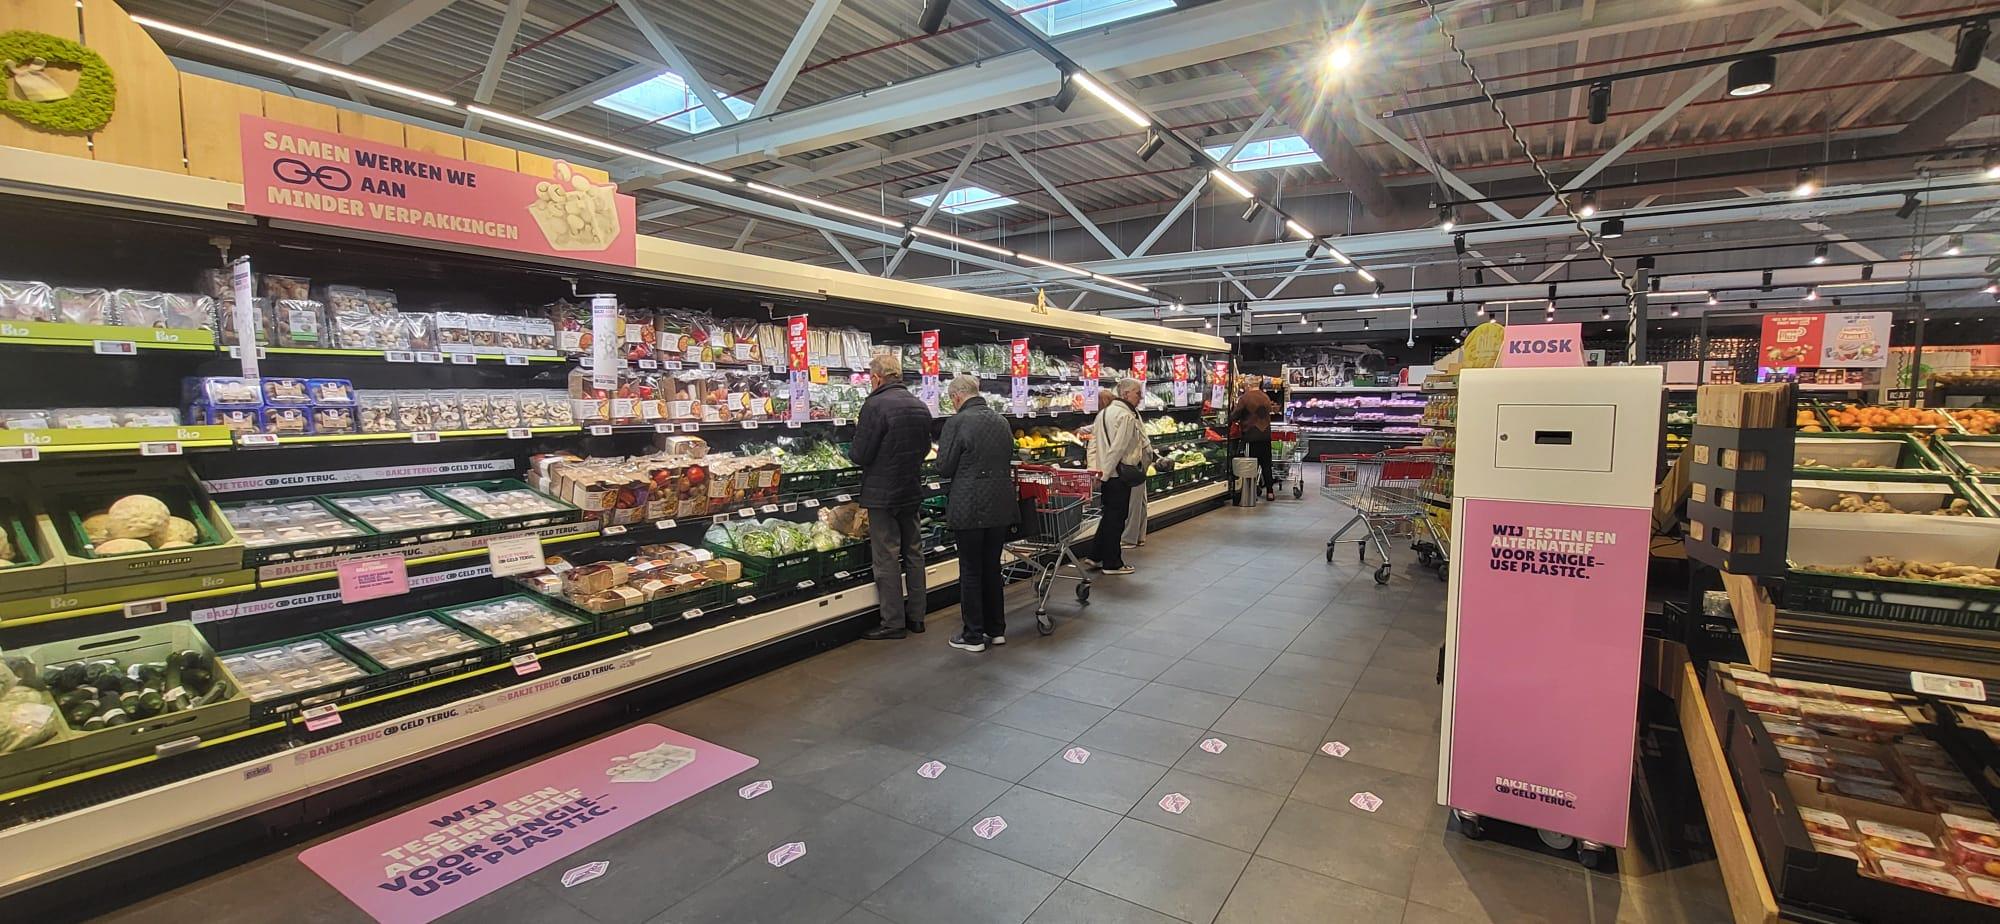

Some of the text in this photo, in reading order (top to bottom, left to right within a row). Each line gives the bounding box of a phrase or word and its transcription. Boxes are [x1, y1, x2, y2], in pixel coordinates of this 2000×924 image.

[264, 131, 477, 187] SAMEN WERKEN WE
[361, 177, 406, 198] AAN
[268, 186, 519, 240] MINDER VERPAKKINGEN
[1508, 338, 1573, 354] KIOSK
[385, 469, 411, 477] BAKJE
[470, 462, 495, 470] TERUG.
[231, 479, 264, 489] TERUG
[281, 477, 304, 486] GELD
[306, 473, 337, 482] TERUG.
[555, 526, 579, 534] TERUG.
[1492, 524, 1616, 544] WIJ TESTEN EEN
[1491, 535, 1593, 555] ALTERNATIEF
[1491, 547, 1536, 561] VOOR
[276, 563, 311, 575] BAKJE
[421, 574, 446, 584] TERUG
[457, 569, 476, 577] GELD
[1490, 559, 1590, 579] USE PLASTIC.
[207, 591, 341, 619] BAKJE TERUG GELD TERU
[507, 663, 616, 700] BAKJE TERUG GELD TERUG.
[308, 708, 459, 758] BAKJE TERUG GELD TERUG.
[1495, 776, 1565, 799] BAKJE TERUG
[1511, 788, 1577, 809] GELD TERUG.
[381, 786, 561, 860] TESTEN EEN
[429, 799, 498, 828] WIJ
[383, 788, 584, 879] ALTERNATIEF
[407, 804, 619, 897] USE PLASTIC.
[377, 844, 490, 892] VOOR
